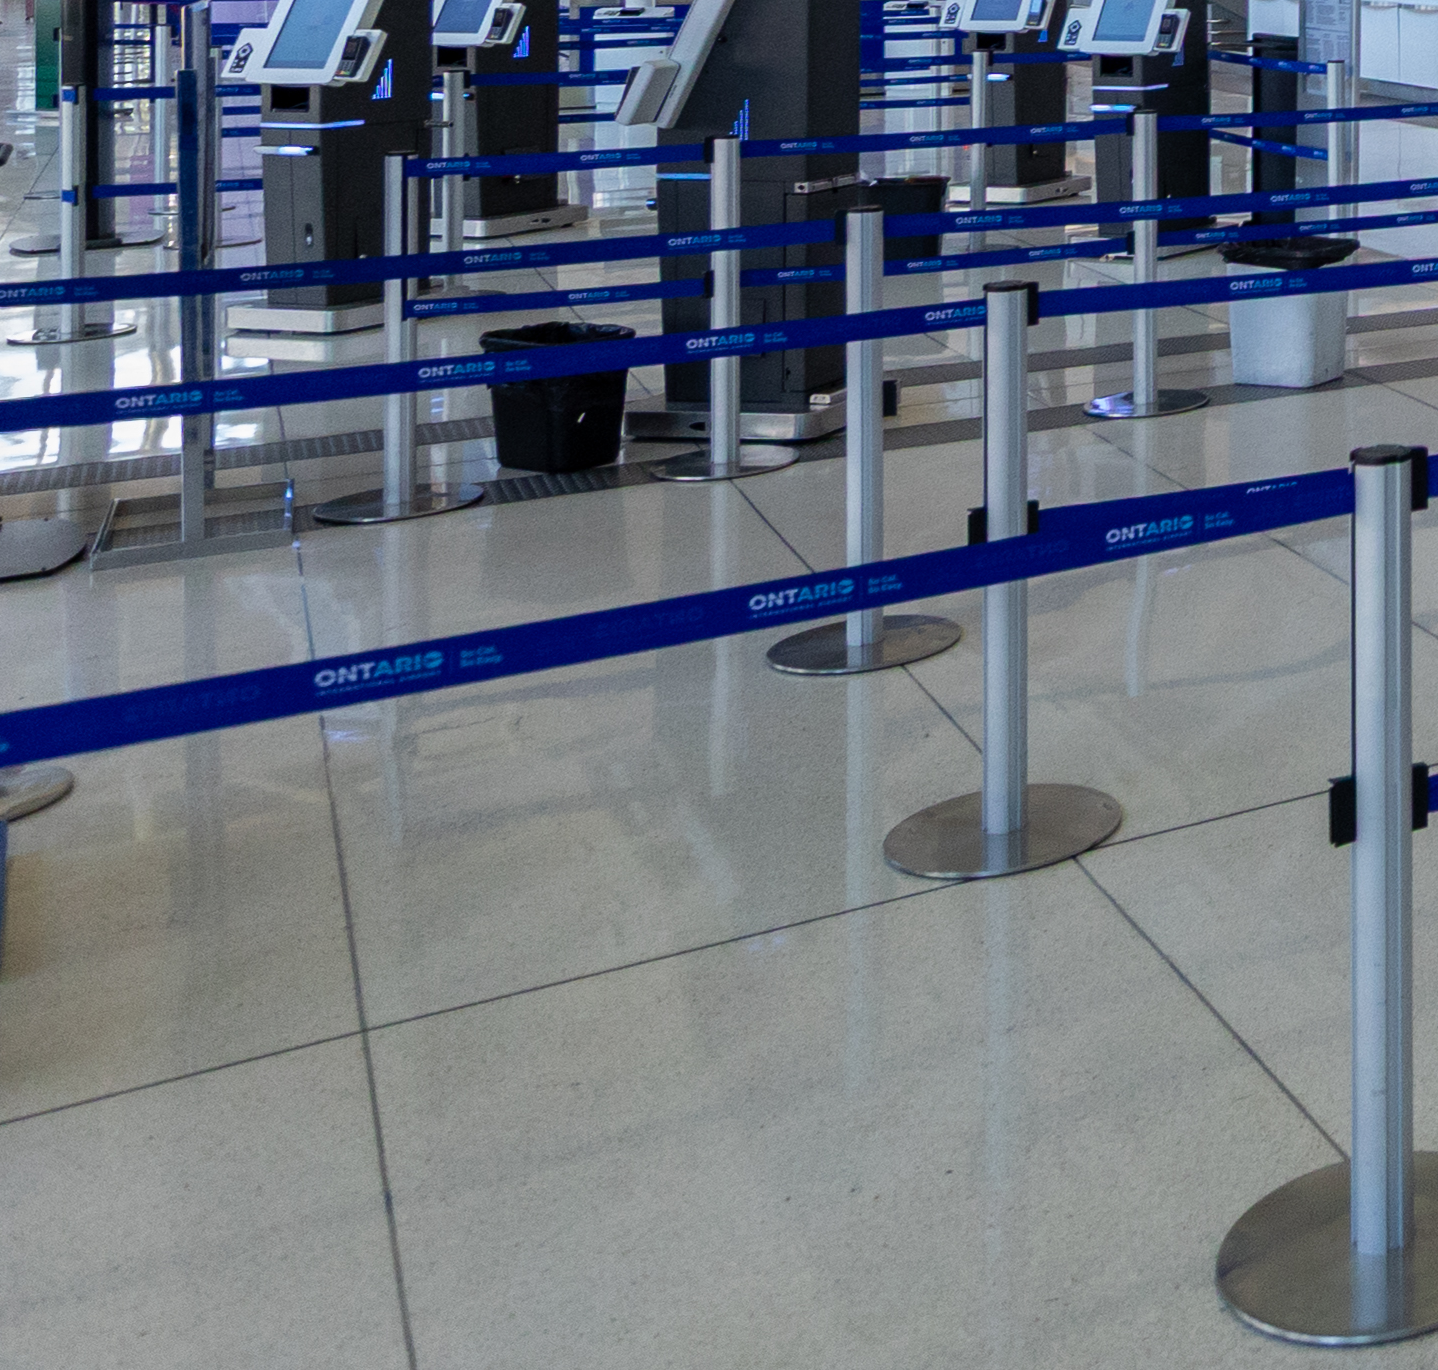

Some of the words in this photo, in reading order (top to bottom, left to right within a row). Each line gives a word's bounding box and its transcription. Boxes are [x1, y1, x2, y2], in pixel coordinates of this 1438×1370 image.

[1105, 514, 1195, 544] ONTARIO
[748, 577, 856, 611] ONTARIO
[314, 650, 444, 689] ONTARIO
